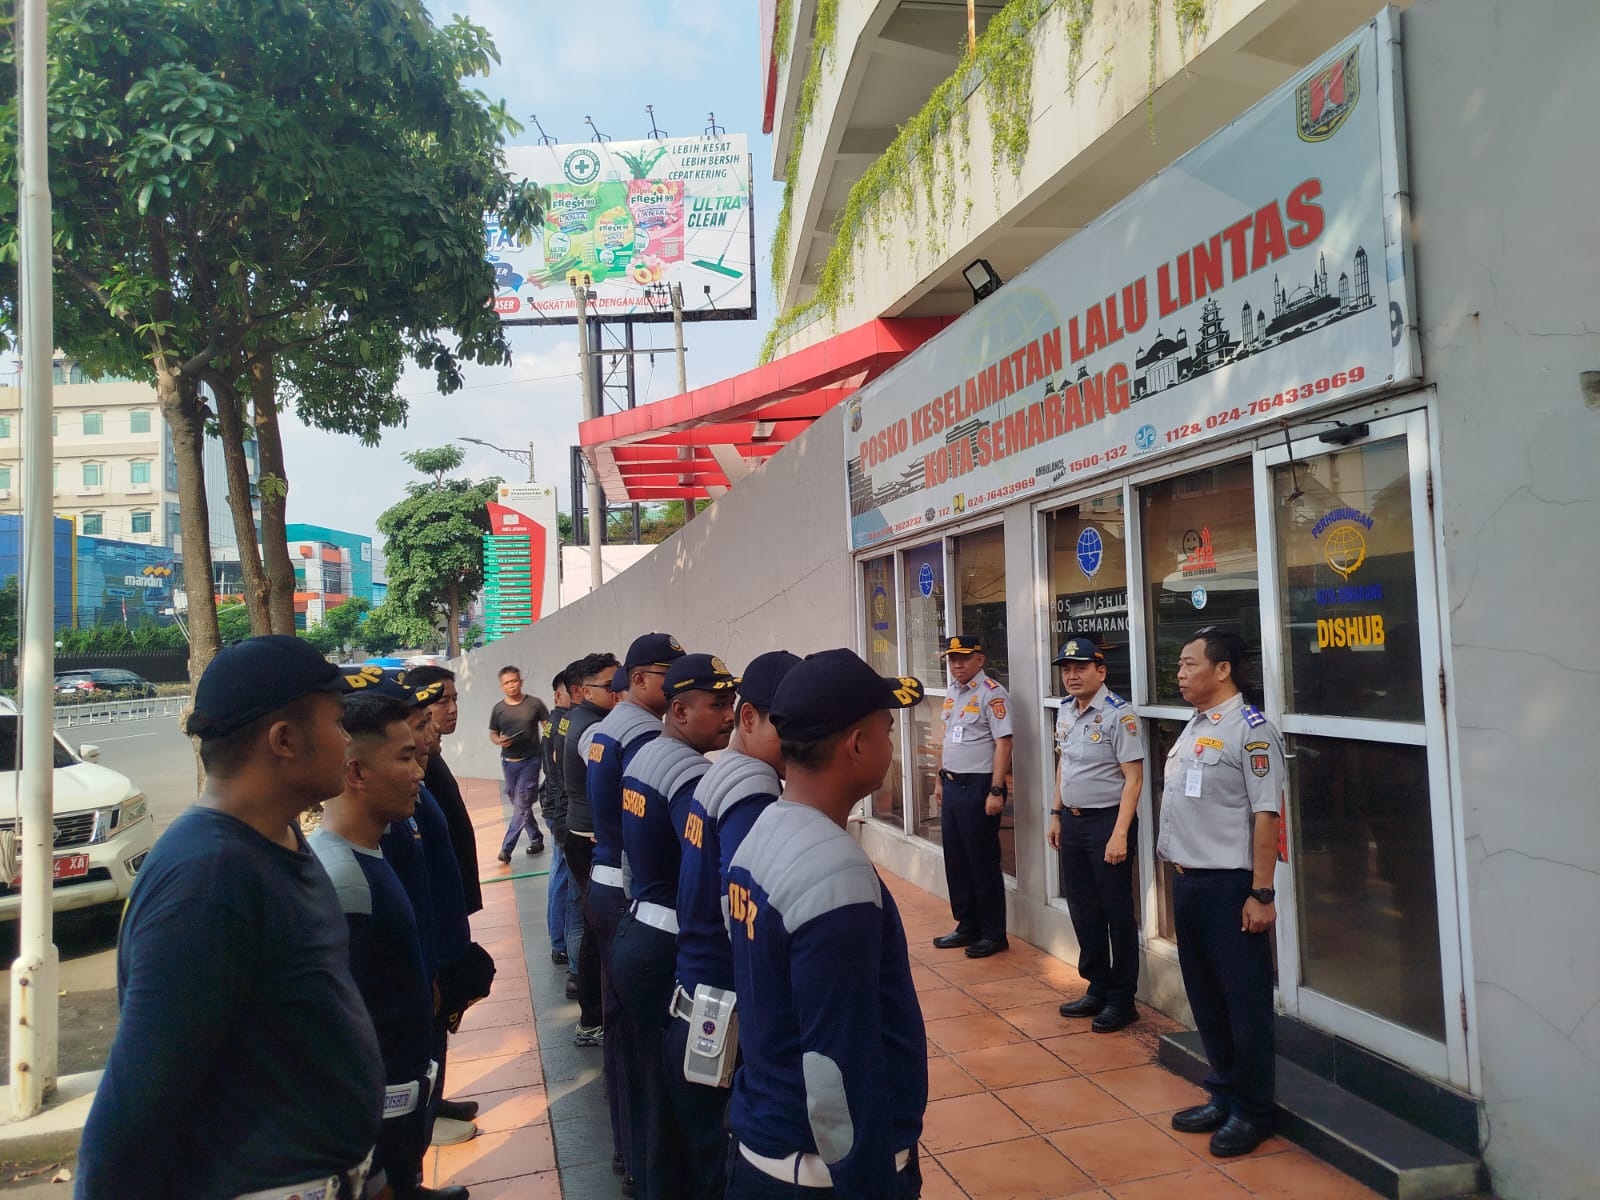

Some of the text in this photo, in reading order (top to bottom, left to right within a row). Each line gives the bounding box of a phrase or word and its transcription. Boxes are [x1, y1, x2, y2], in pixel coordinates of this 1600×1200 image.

[672, 142, 731, 155] LEBIH KESAT
[681, 154, 740, 167] LEBIH BERSIH
[668, 169, 727, 180] CEPAT KERING
[693, 195, 742, 211] ULTRA
[687, 212, 727, 228] CLEAN
[531, 300, 565, 311] ANGKAT
[599, 297, 635, 307] DENGAN
[860, 177, 1325, 472] POSKO KESELAMATAN LALU LINTAS
[1206, 366, 1366, 429] 024-76433969
[925, 362, 1131, 489] KOTA SEMARANG
[1035, 458, 1064, 477] AMBULANCE
[1069, 445, 1128, 473] 1500-132
[967, 477, 1036, 508] 024-76433969
[1311, 507, 1374, 539] PERHUBUNGAN
[1051, 620, 1074, 633] KOTA
[1316, 614, 1385, 649] DISHUB
[69, 857, 85, 870] XA
